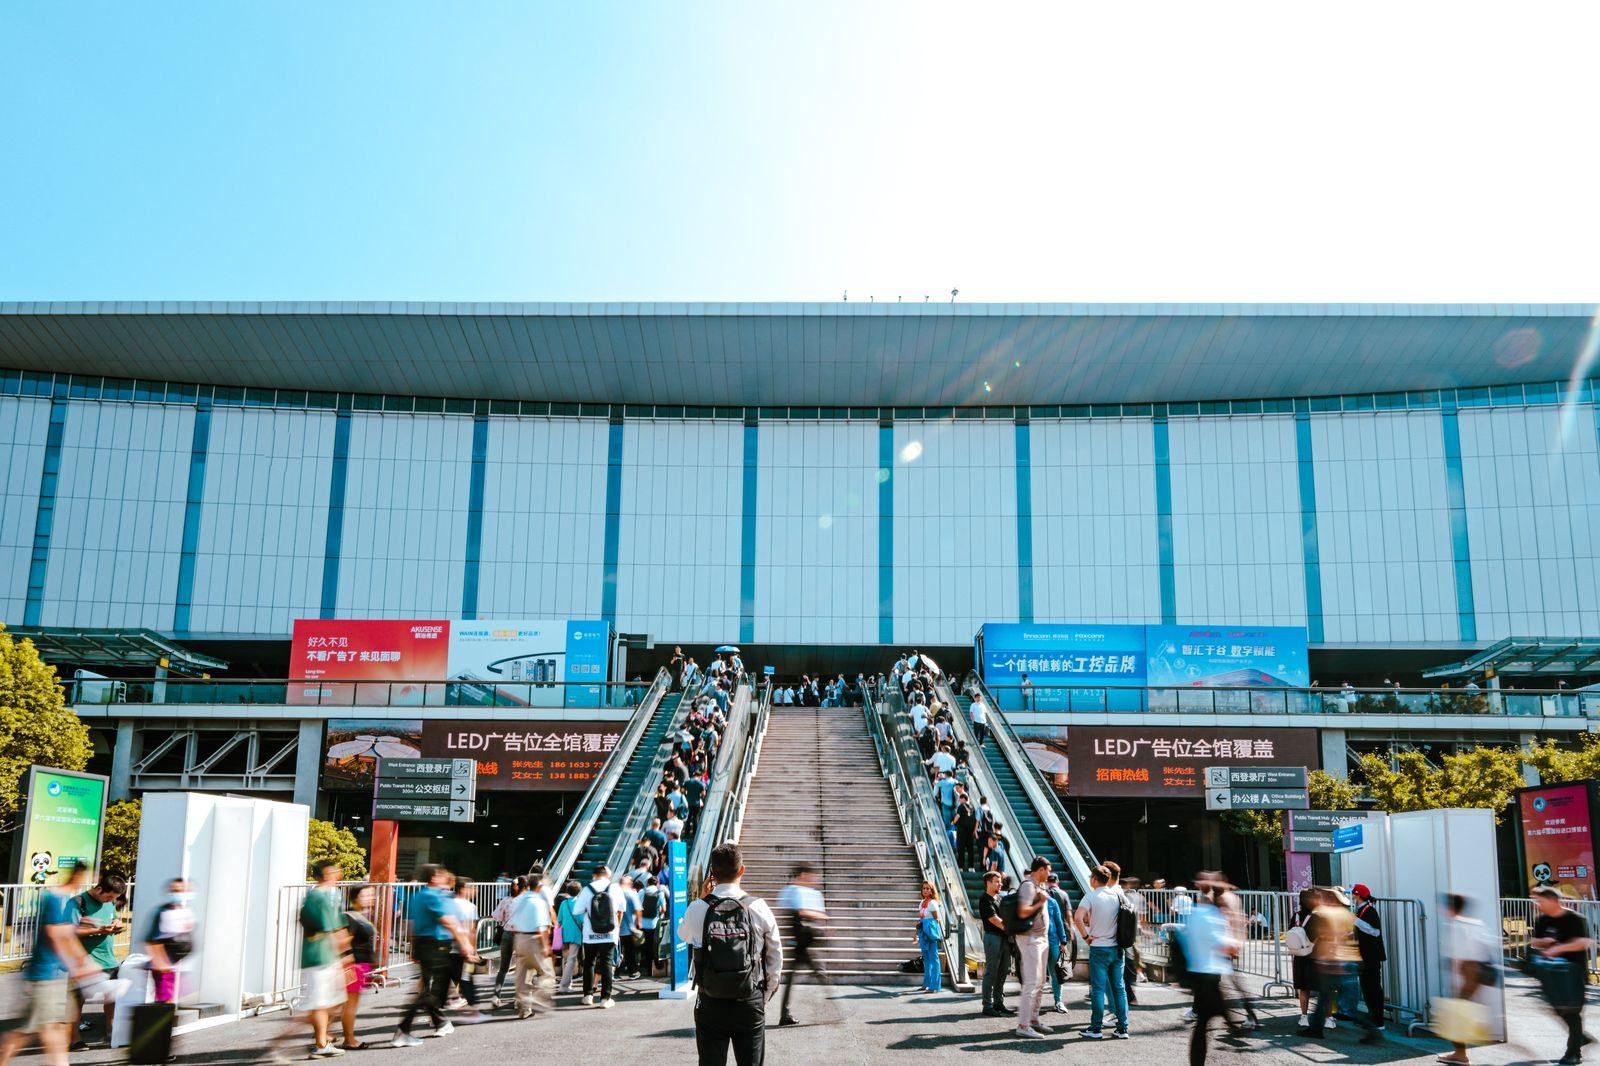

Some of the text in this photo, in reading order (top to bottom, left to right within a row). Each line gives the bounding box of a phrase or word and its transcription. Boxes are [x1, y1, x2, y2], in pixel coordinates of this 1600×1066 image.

[308, 636, 348, 648] 好久不见
[1230, 645, 1276, 656] 数字赋能
[306, 651, 400, 662] 不看广告了 来见面聊
[448, 732, 620, 752] LED广告位全馆覆盖
[1094, 738, 1274, 758] LED广告位全馆覆盖
[416, 763, 452, 774] 西登录厅
[512, 760, 544, 768] 张先生
[1096, 768, 1150, 782] 招商热线
[1163, 766, 1196, 774] 张先生
[1230, 772, 1266, 782] 西登录厅
[415, 784, 450, 794] 公交枢纽
[1232, 794, 1270, 804] 办公楼 A
[413, 805, 448, 816] 洲际酒店
